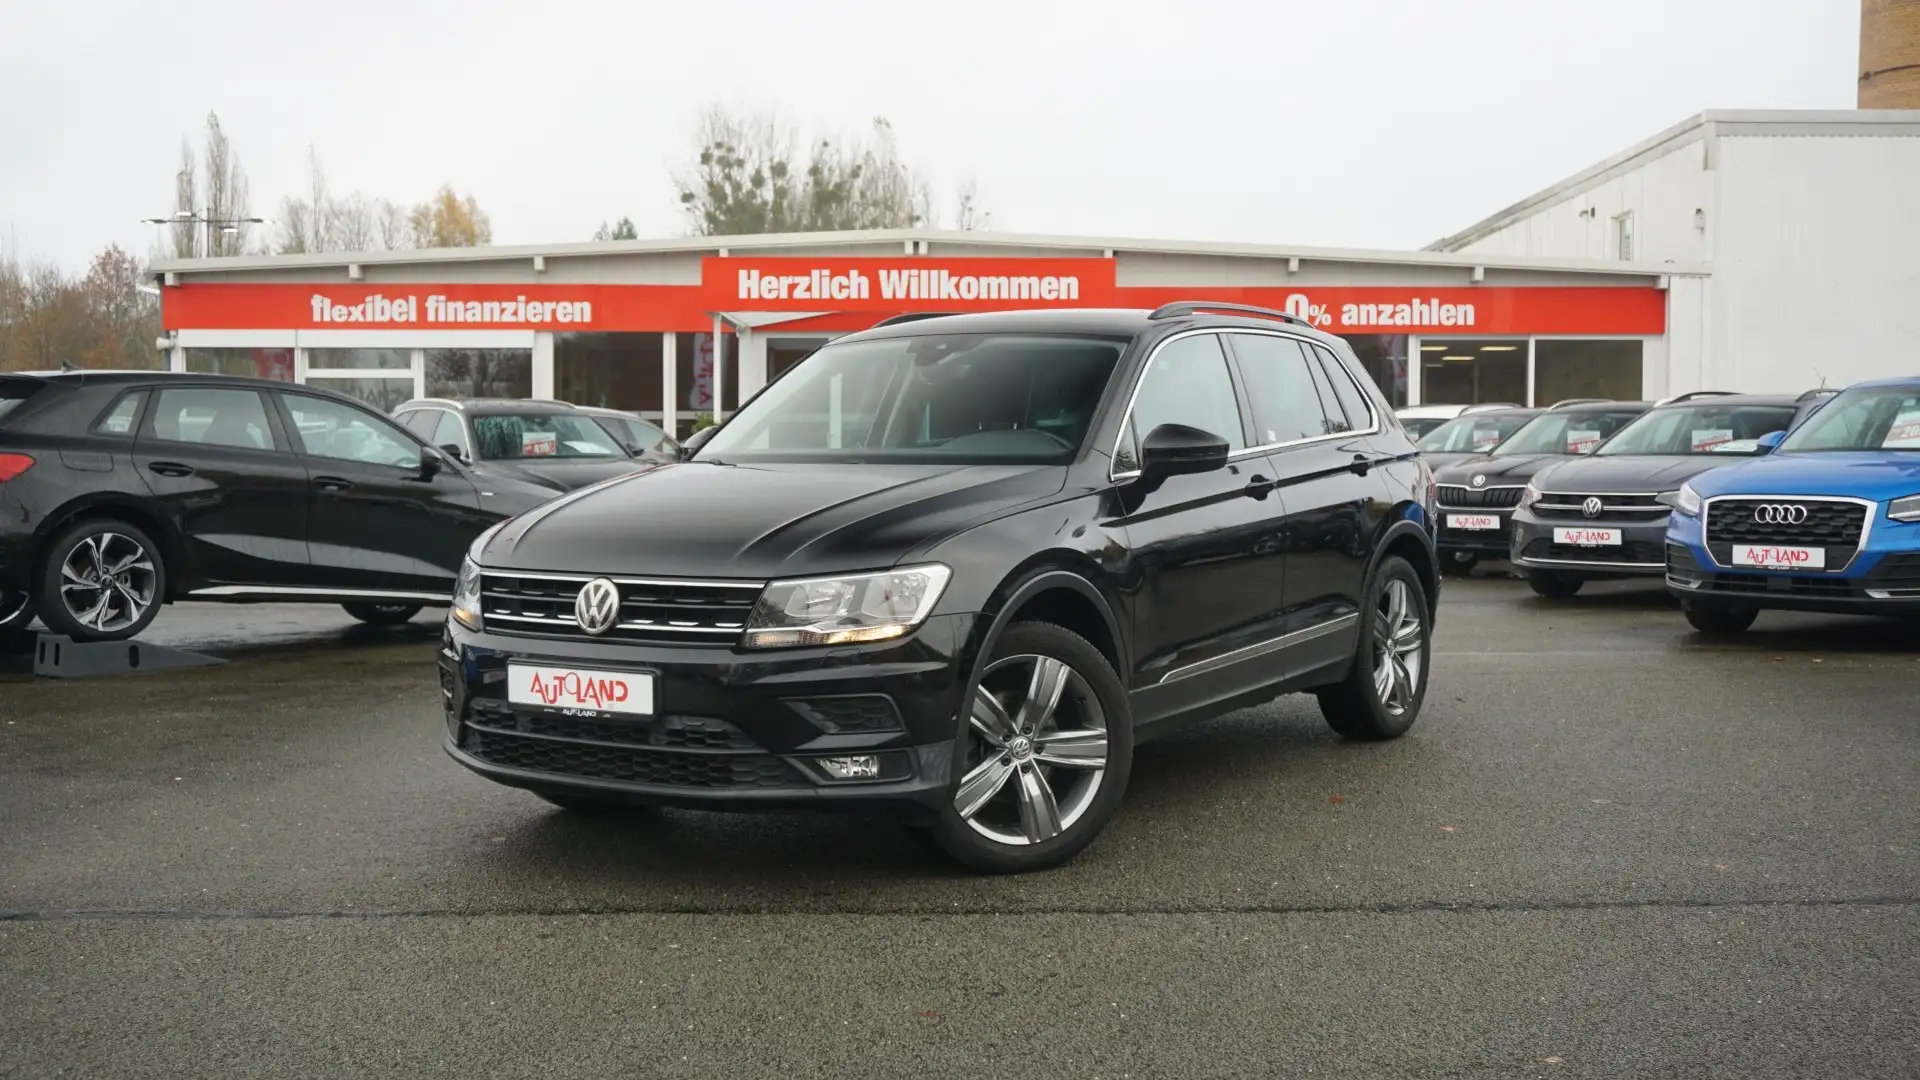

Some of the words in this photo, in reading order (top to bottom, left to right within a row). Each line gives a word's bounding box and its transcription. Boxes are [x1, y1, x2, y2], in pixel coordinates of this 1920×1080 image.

[738, 269, 869, 300] Herzlich
[879, 268, 1079, 300] Willkommen
[310, 294, 416, 323] flexibel
[425, 295, 592, 323] finanzieren
[1285, 293, 1332, 326] 0%
[1340, 298, 1476, 327] anzahlen
[1455, 517, 1491, 528] AUTOLAND
[1564, 530, 1611, 543] AUTOLAND
[1746, 547, 1810, 565] AUTOLAND
[530, 671, 629, 709] AUTOLAND
